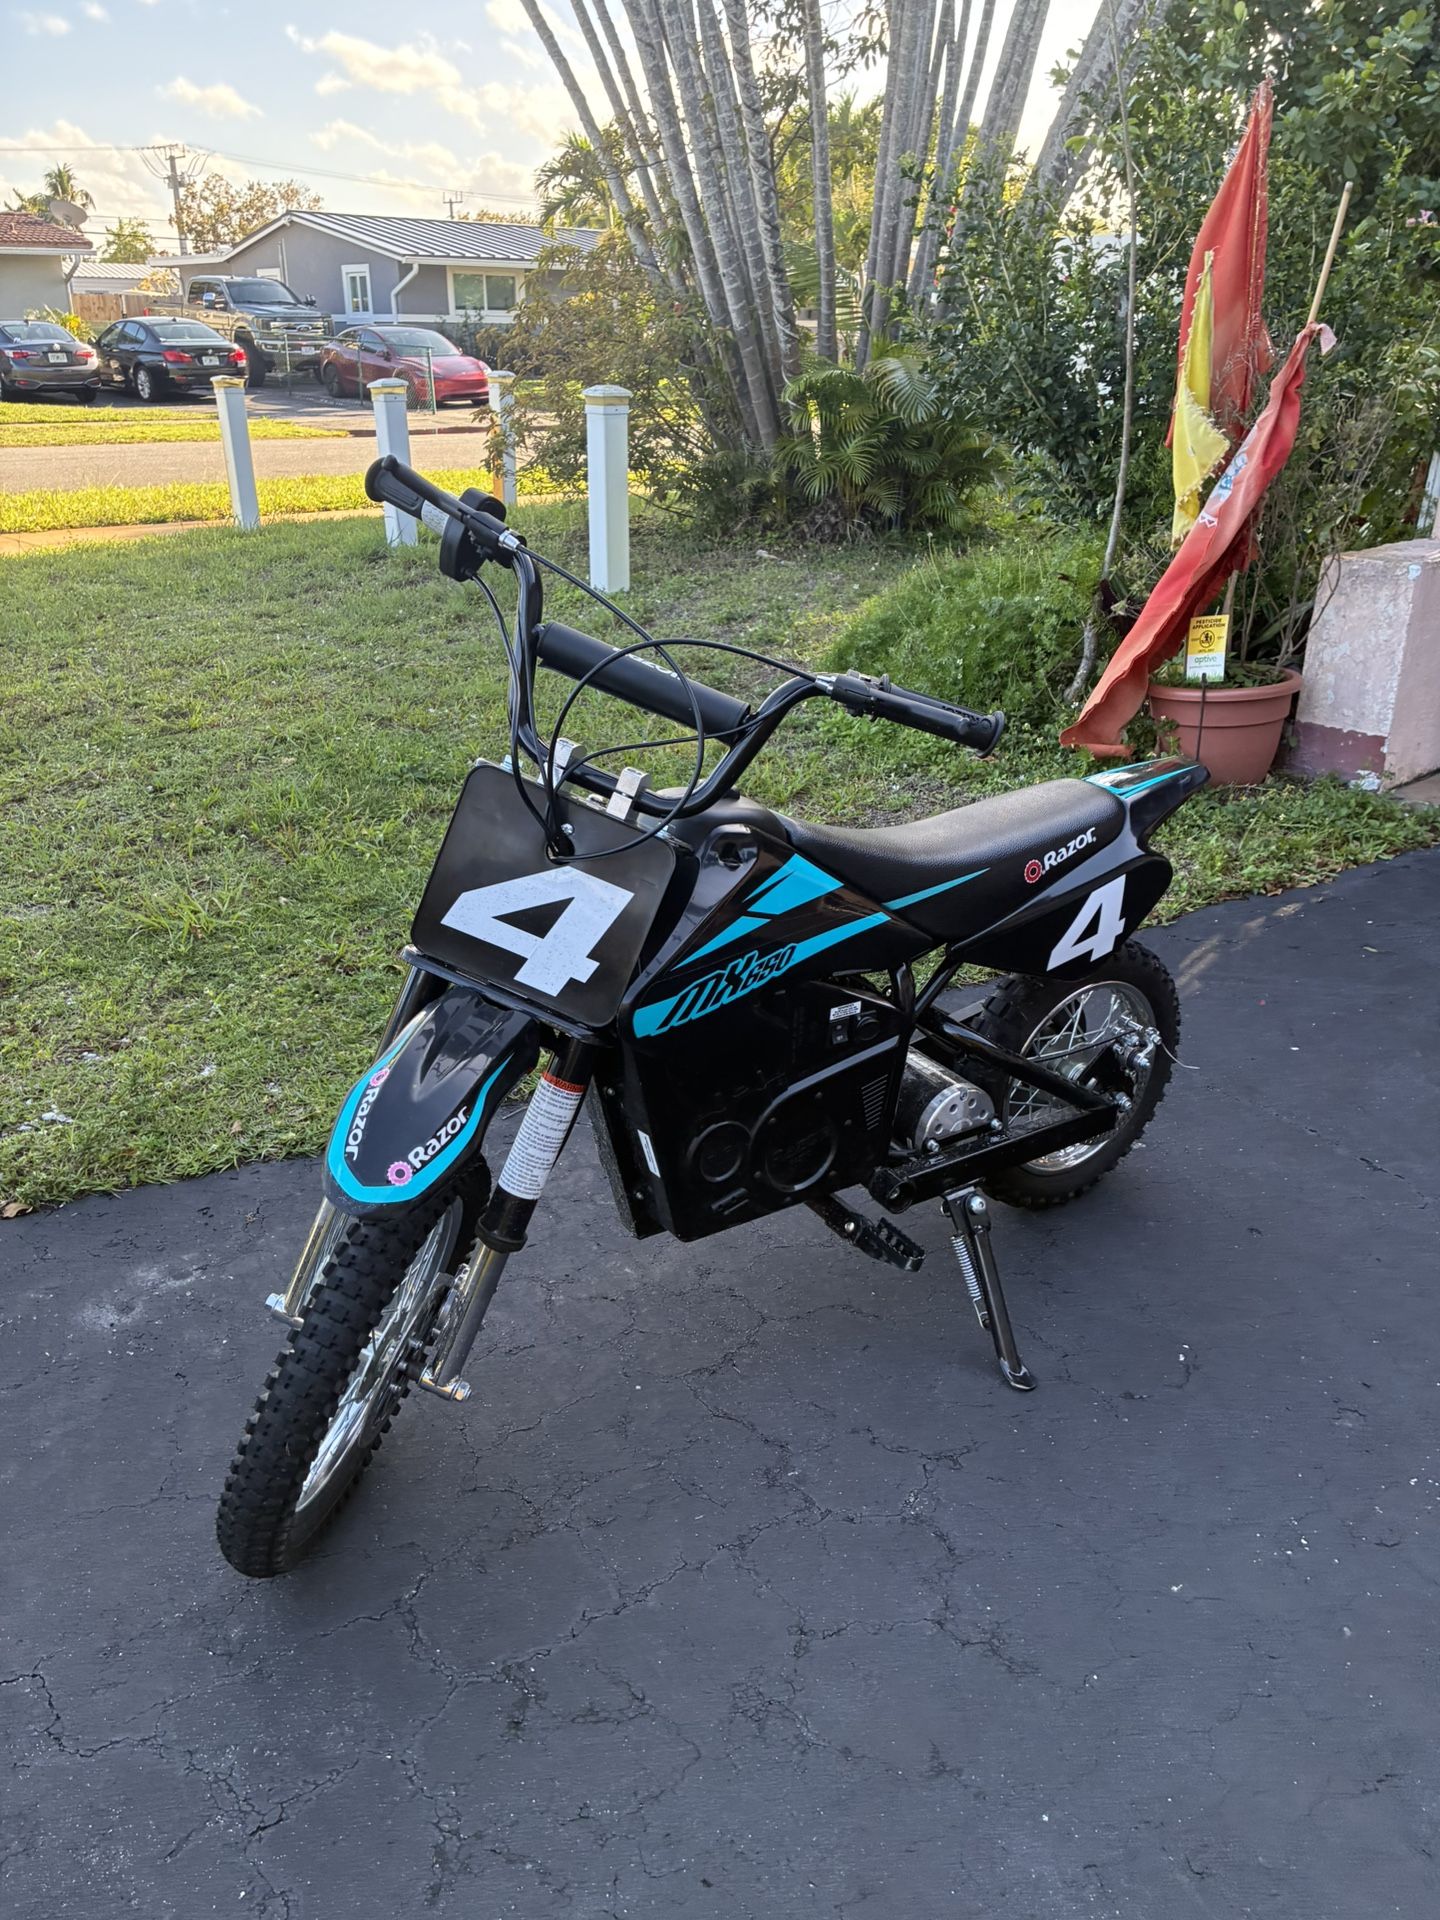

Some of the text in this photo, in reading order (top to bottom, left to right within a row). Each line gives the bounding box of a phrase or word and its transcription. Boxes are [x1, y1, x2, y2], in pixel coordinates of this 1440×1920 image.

[1043, 827, 1096, 871] Razor
[440, 866, 635, 997] 4
[1046, 873, 1127, 972] 4
[345, 1087, 380, 1161] Razor
[407, 1105, 468, 1169] Razor
